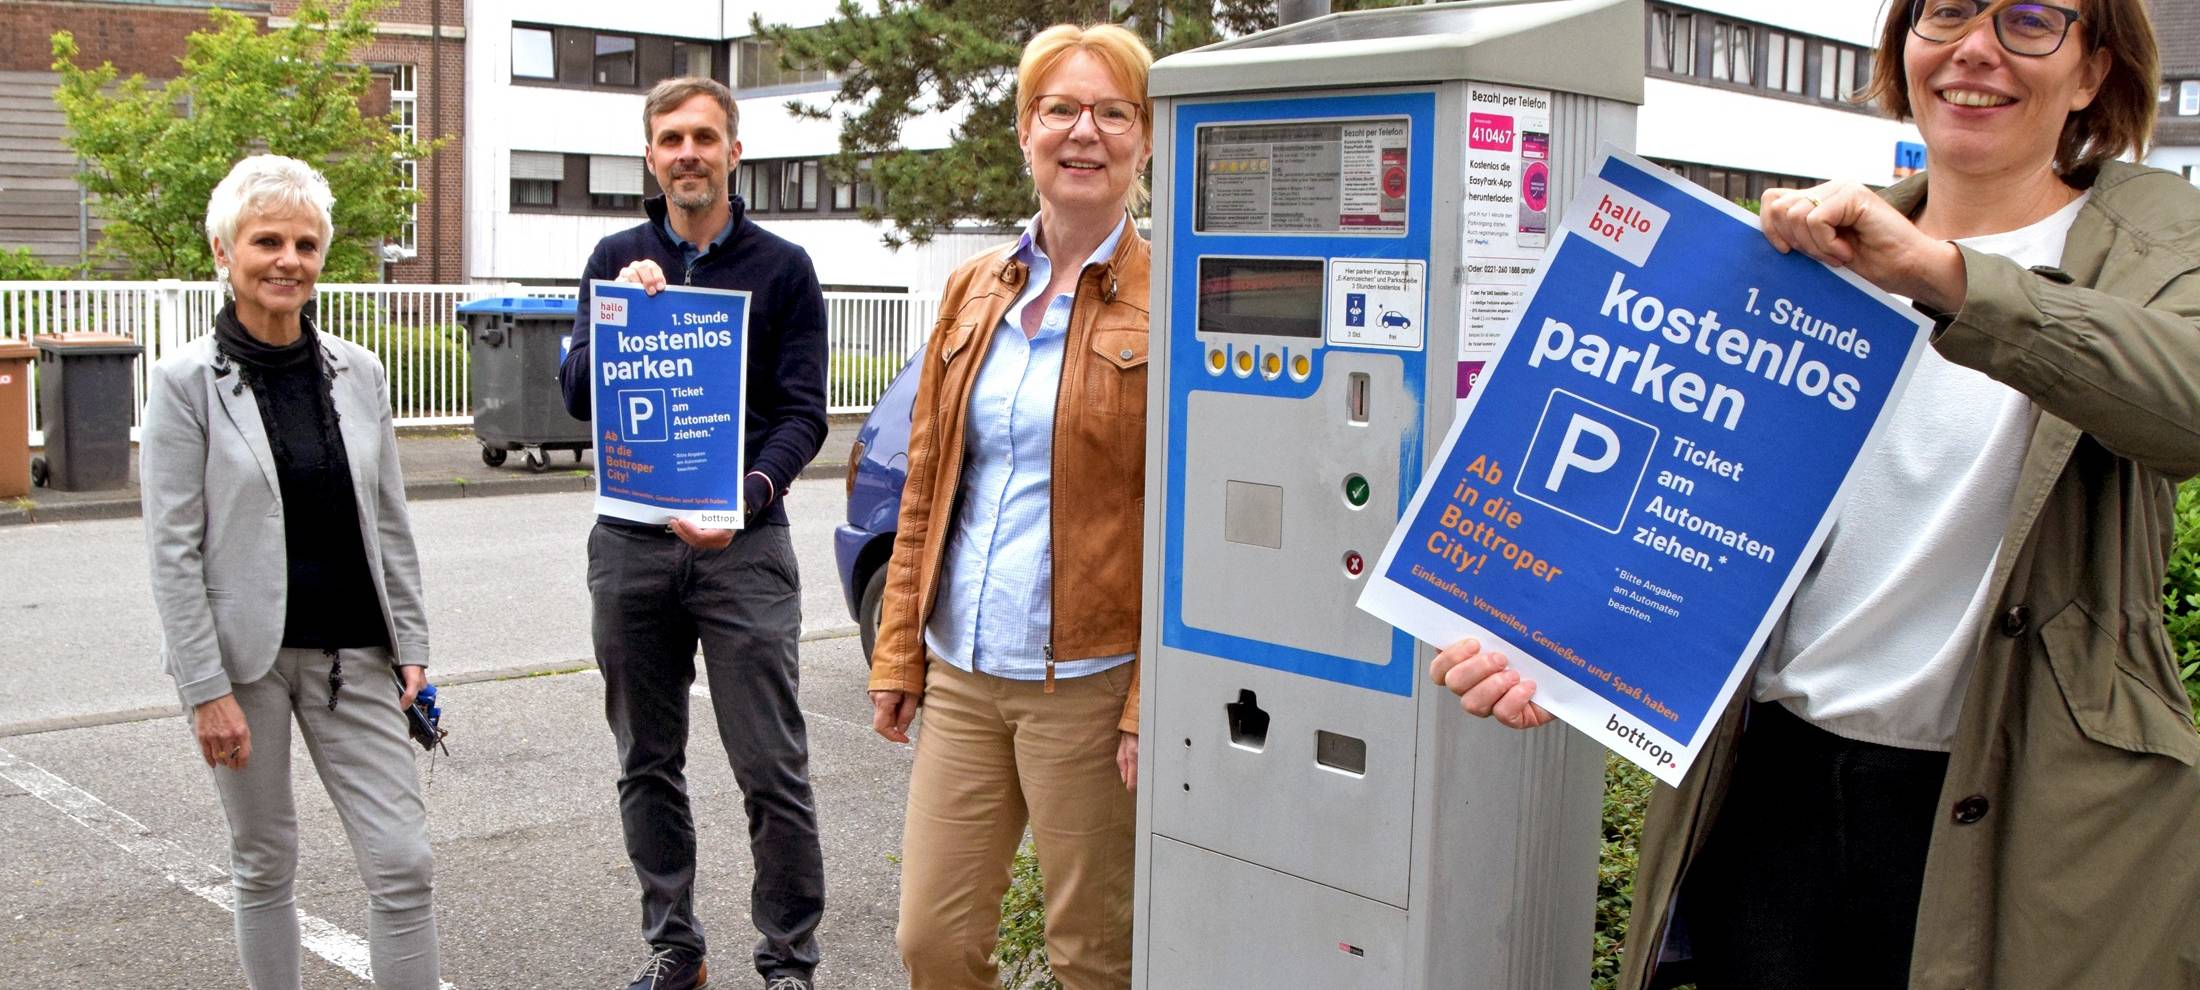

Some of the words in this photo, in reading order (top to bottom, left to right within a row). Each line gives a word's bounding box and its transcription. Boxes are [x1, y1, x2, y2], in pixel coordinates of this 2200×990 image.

[1472, 90, 1500, 104] Bezahl
[1503, 96, 1517, 107] per
[1519, 96, 1547, 109] Telefon
[1344, 129, 1364, 137] Bezahl
[1366, 129, 1377, 138] per
[1379, 128, 1403, 136] Telefon
[1472, 127, 1511, 144] 410467
[1470, 160, 1499, 170] Kostenlos
[1501, 163, 1510, 171] die
[1469, 176, 1512, 189] EasyPark-App
[1469, 192, 1513, 203] herunterladen
[1598, 194, 1651, 234] hallo
[1588, 212, 1625, 243] bot
[1374, 269, 1400, 277] Fahrzeuge
[600, 302, 623, 312] hallo
[600, 311, 614, 320] bot
[672, 313, 681, 326] 1.
[684, 311, 728, 325] Stunde
[1745, 287, 1761, 316] 1.
[1770, 298, 1871, 360] Stunde
[618, 327, 732, 352] kostenlos
[1600, 271, 1861, 411] kostenlos
[602, 355, 693, 386] parken
[1528, 317, 1745, 431] parken
[671, 386, 704, 398] Ticket
[629, 397, 654, 435] P
[672, 403, 688, 412] am
[673, 413, 731, 426] Automaten
[604, 430, 618, 442] Ab
[604, 445, 614, 454] in
[617, 445, 632, 457] die
[1545, 412, 1621, 493] P
[1672, 436, 1744, 482] Ticket
[606, 455, 655, 474] Bottroper
[607, 468, 630, 484] City!
[1466, 453, 1504, 485] Ab
[1657, 468, 1695, 496] am
[1453, 478, 1480, 507] in
[1482, 495, 1523, 530] die
[701, 513, 738, 524] bottrop.
[1645, 495, 1775, 563] Automaten
[1425, 530, 1488, 577] City!
[1439, 503, 1563, 584] Bottroper
[1613, 585, 1628, 597] am
[1629, 588, 1680, 619] Automaten
[1644, 579, 1684, 605] Angaben
[1608, 598, 1652, 623] beachten.
[1411, 564, 1470, 603] Einkaufen,
[1472, 596, 1529, 638] Verweilen,
[1531, 629, 1586, 669] Genießen
[1587, 663, 1612, 683] und
[1611, 676, 1642, 700] Spaß
[1642, 693, 1680, 722] haben
[1605, 713, 1676, 770] bottrop.
